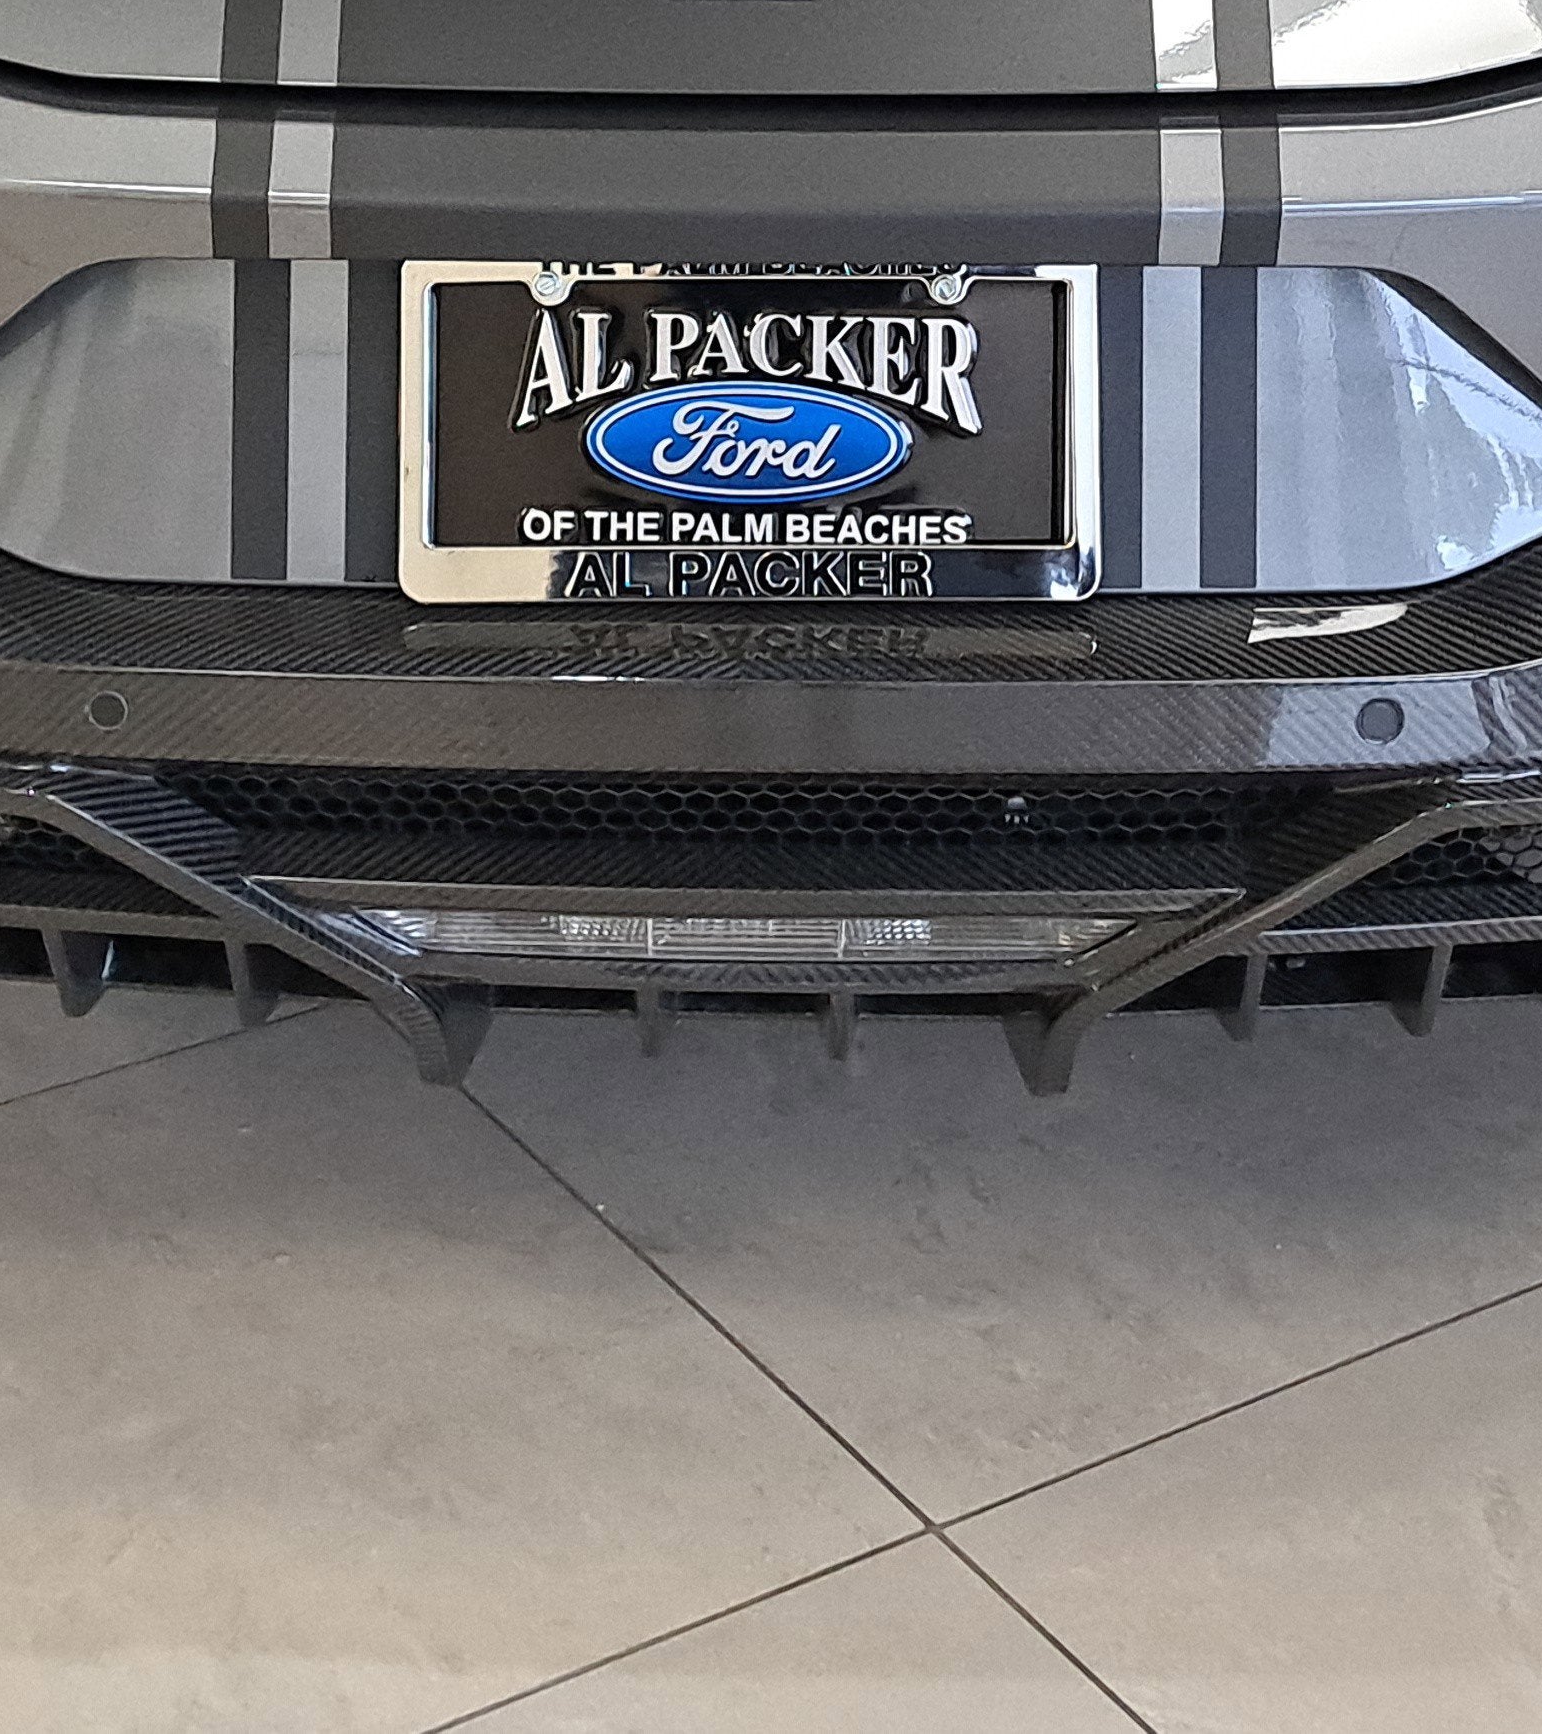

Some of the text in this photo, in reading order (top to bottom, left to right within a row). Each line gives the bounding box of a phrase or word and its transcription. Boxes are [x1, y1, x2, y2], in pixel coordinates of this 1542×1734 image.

[514, 308, 982, 434] AL PACKER
[651, 398, 841, 479] Ford
[521, 507, 972, 545] OF THE PALM BEACHES
[564, 551, 934, 598] AL PACKER
